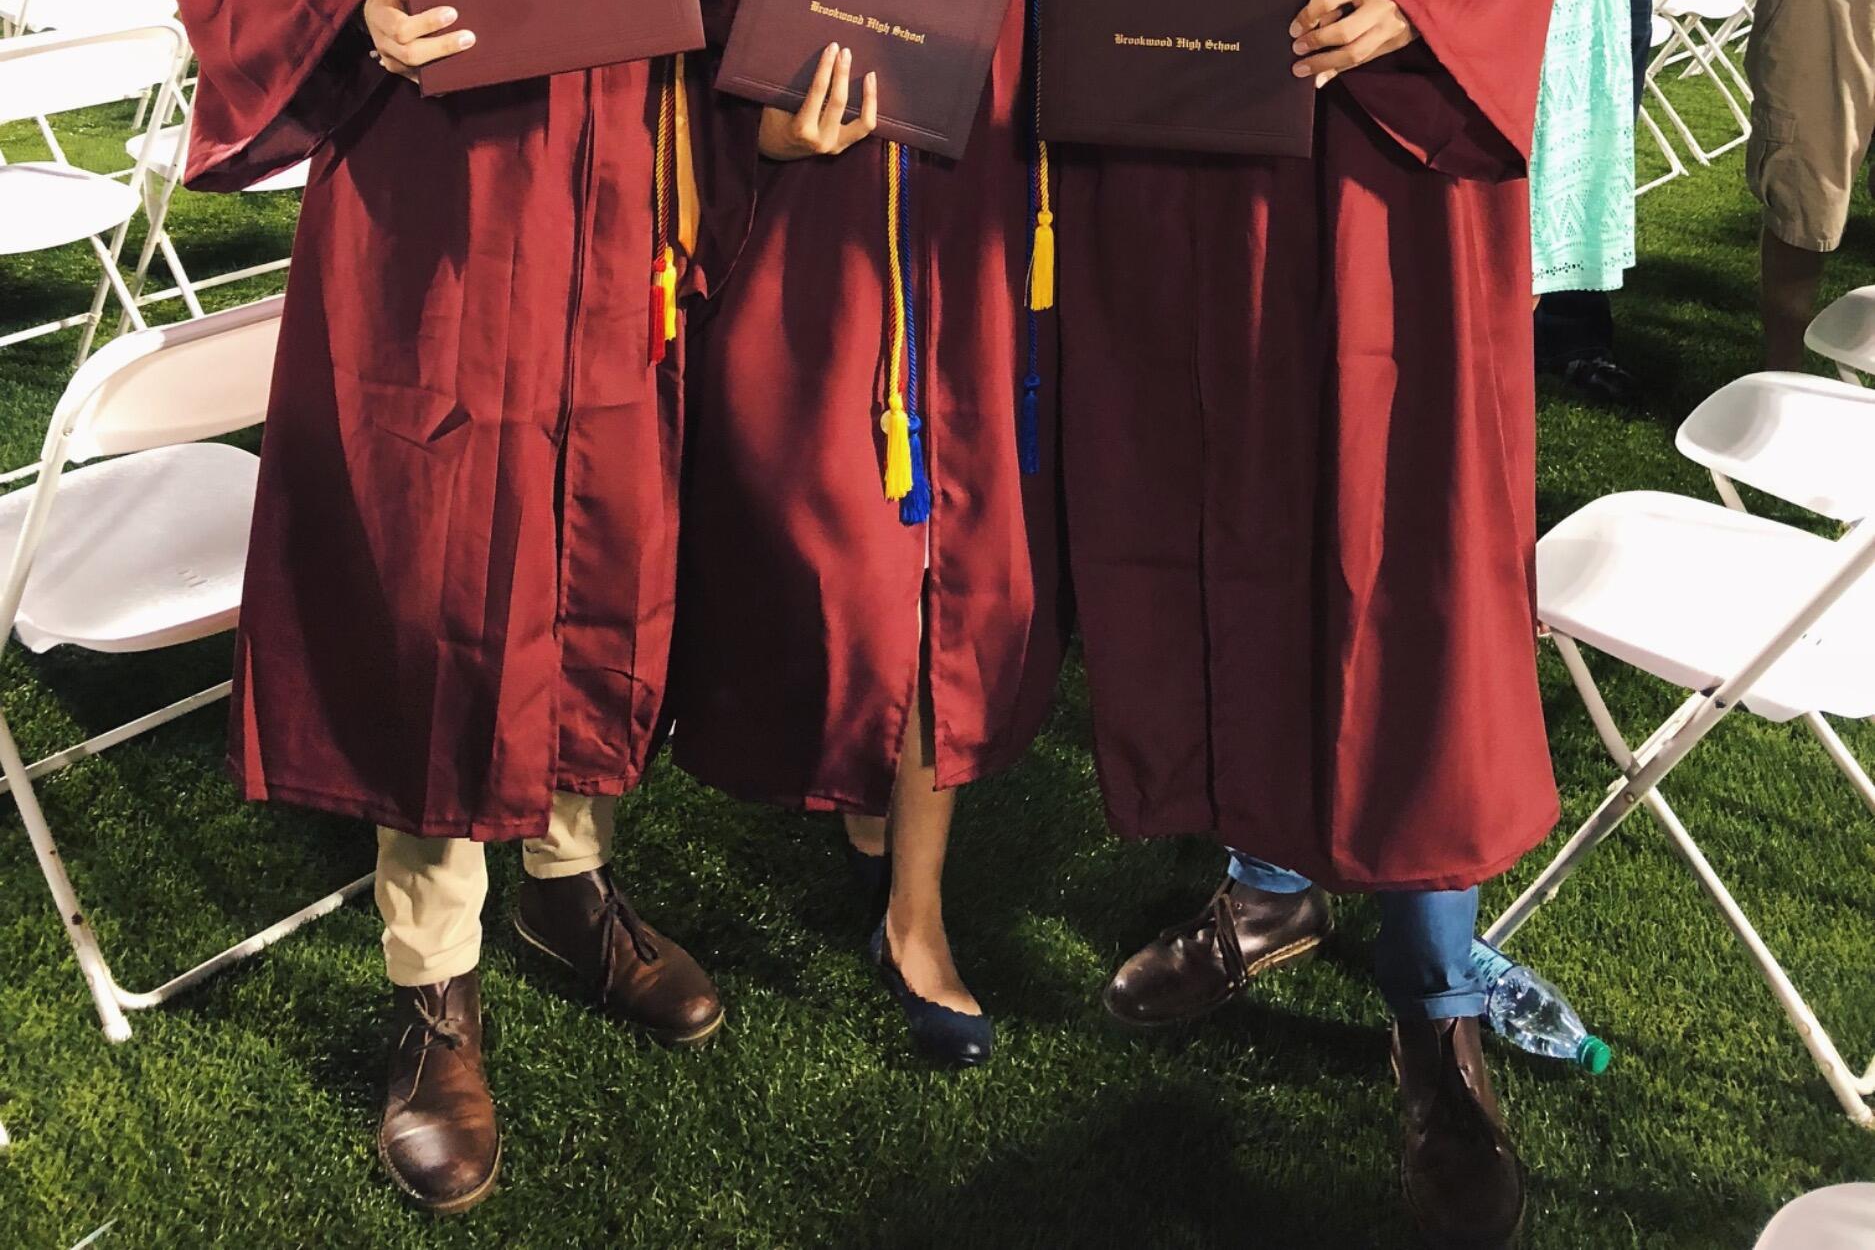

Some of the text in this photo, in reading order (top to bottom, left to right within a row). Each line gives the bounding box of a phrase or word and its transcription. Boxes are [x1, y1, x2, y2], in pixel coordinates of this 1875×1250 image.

[810, 0, 925, 44] Brookwood High School
[1114, 33, 1240, 53] Brookwood High School
